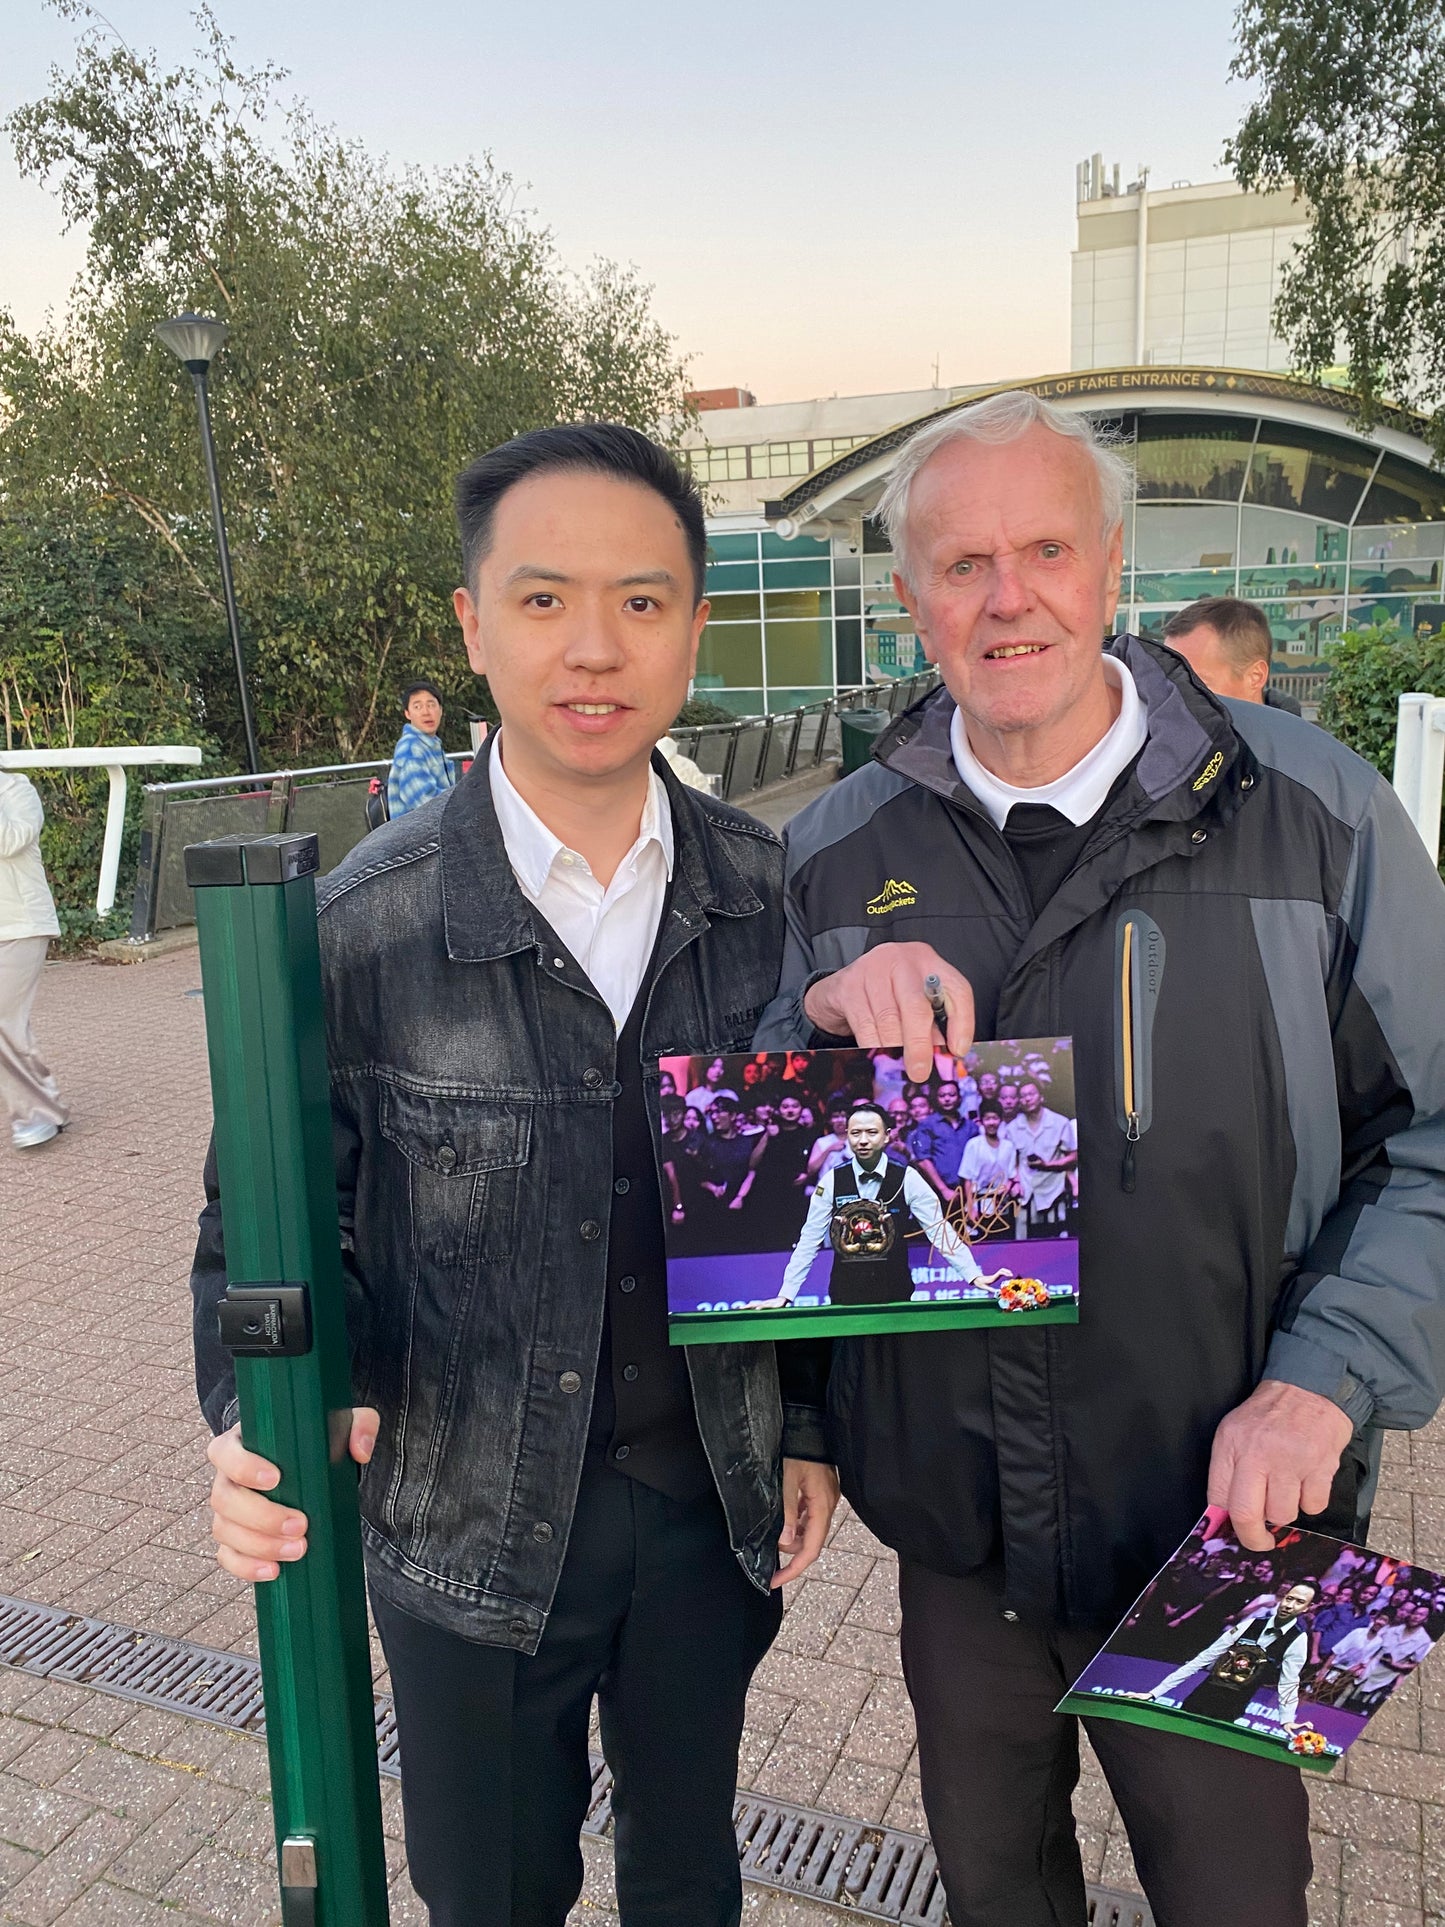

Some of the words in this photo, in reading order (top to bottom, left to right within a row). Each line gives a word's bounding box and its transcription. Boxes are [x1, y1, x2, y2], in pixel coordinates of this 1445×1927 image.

[1029, 384, 1052, 397] ALL
[1056, 379, 1076, 394] OF
[1079, 373, 1118, 391] FAME
[1121, 372, 1201, 387] ENTRANCE
[1147, 930, 1160, 994] Outdoor
